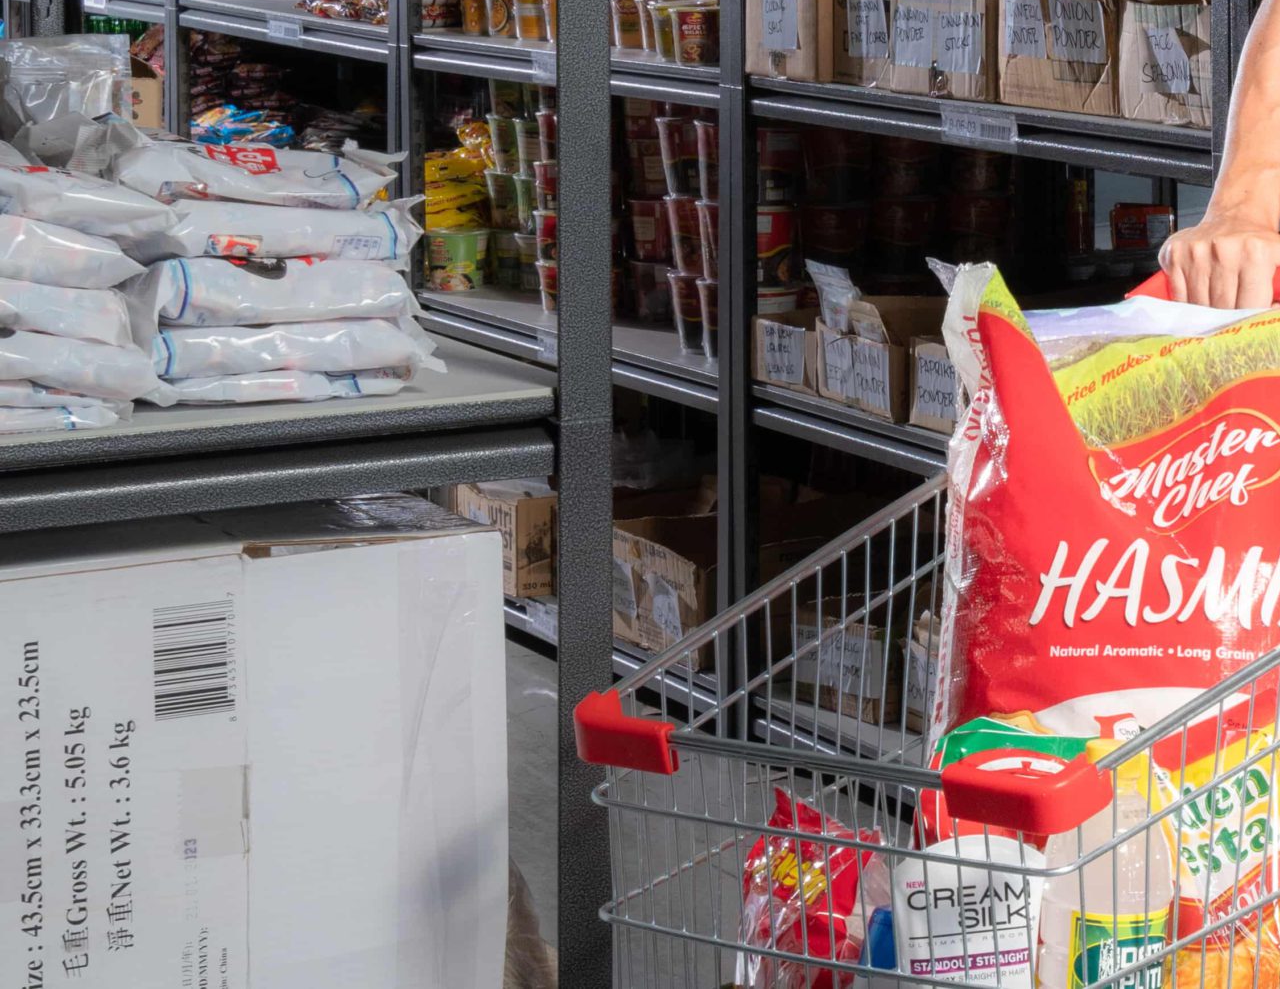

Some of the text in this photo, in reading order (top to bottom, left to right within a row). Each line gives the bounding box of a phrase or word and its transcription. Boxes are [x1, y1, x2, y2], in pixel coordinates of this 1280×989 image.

[1053, 25, 1101, 50] POWDER
[1066, 379, 1097, 405] rice
[1100, 352, 1153, 387] makes
[1153, 463, 1259, 528] Chef
[225, 591, 238, 723] 8 73453 10770 7
[1050, 644, 1255, 661] Natural Aromatic Long Grain
[18, 640, 40, 722] 23.5cm
[25, 727, 41, 741] x
[64, 706, 91, 735] kg
[107, 719, 136, 749] kg
[64, 742, 87, 790] 5.05
[108, 755, 132, 790] 3.6
[20, 748, 42, 830] 33.3cm
[27, 835, 42, 850] x
[64, 811, 87, 854] Wt.
[109, 811, 132, 854] Wt.
[21, 857, 44, 938] 43.5cm
[906, 881, 926, 890] NEW
[907, 881, 1031, 911] CREAM
[957, 904, 1028, 929] SILK
[218, 947, 230, 975] China
[913, 950, 1029, 972] STANDOUT STRAIGHT
[1008, 967, 1028, 977] HAIR
